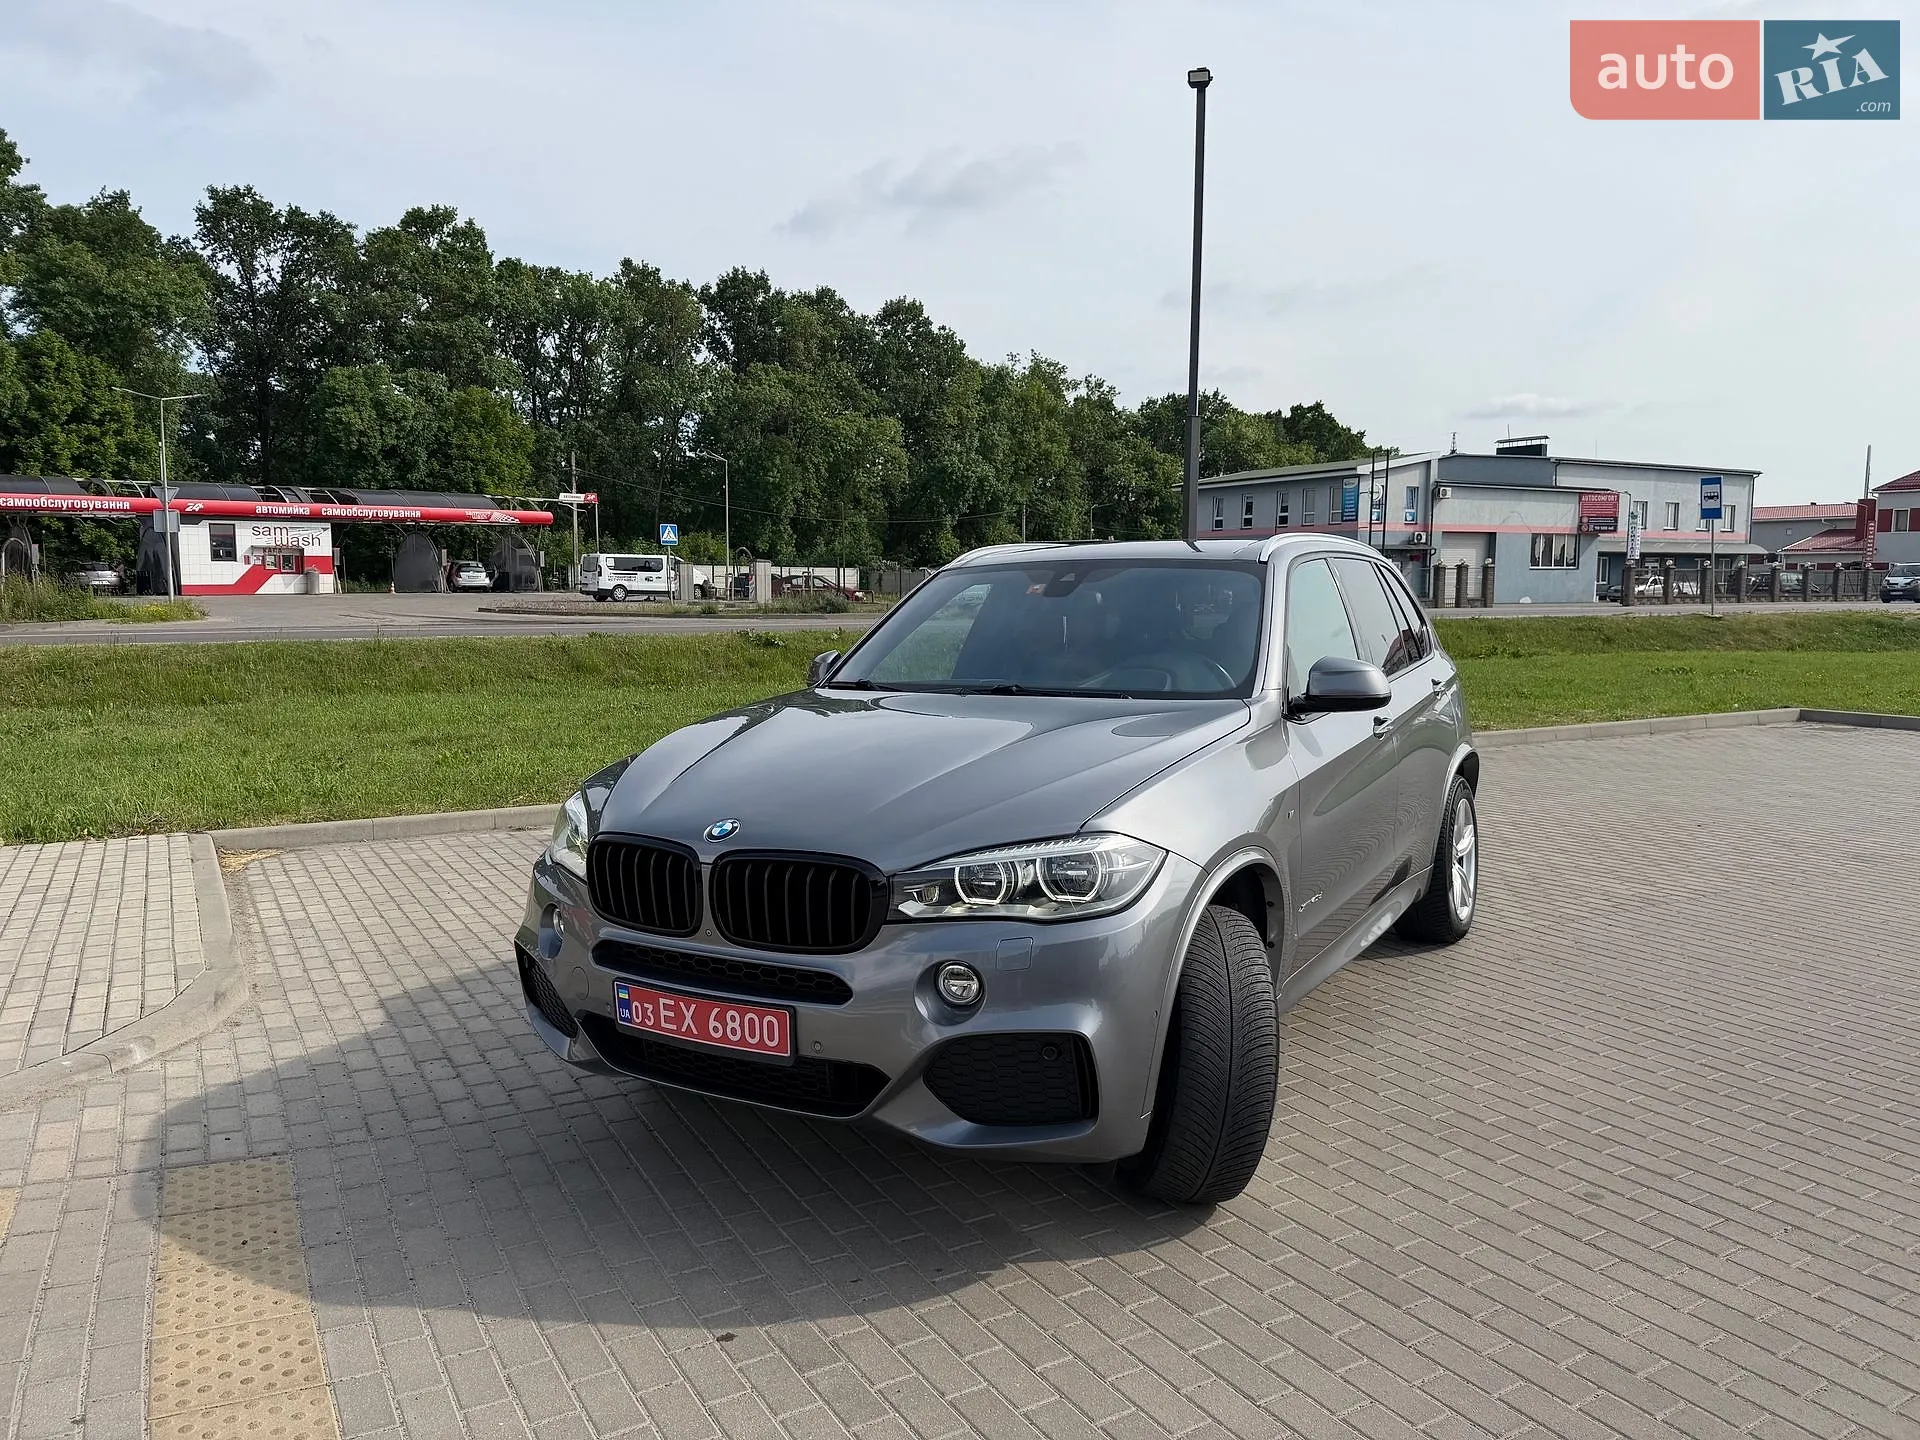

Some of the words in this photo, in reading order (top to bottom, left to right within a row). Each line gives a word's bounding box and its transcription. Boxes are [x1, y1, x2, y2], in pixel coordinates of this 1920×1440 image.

[0, 496, 130, 511] самообслуговування
[255, 504, 310, 516] автомийка
[321, 505, 421, 520] самообслуговування
[251, 525, 289, 537] sam
[274, 534, 321, 547] wash
[620, 1007, 630, 1019] UA
[632, 1001, 654, 1026] 03
[659, 997, 698, 1035] EX
[708, 1007, 780, 1047] 6800
